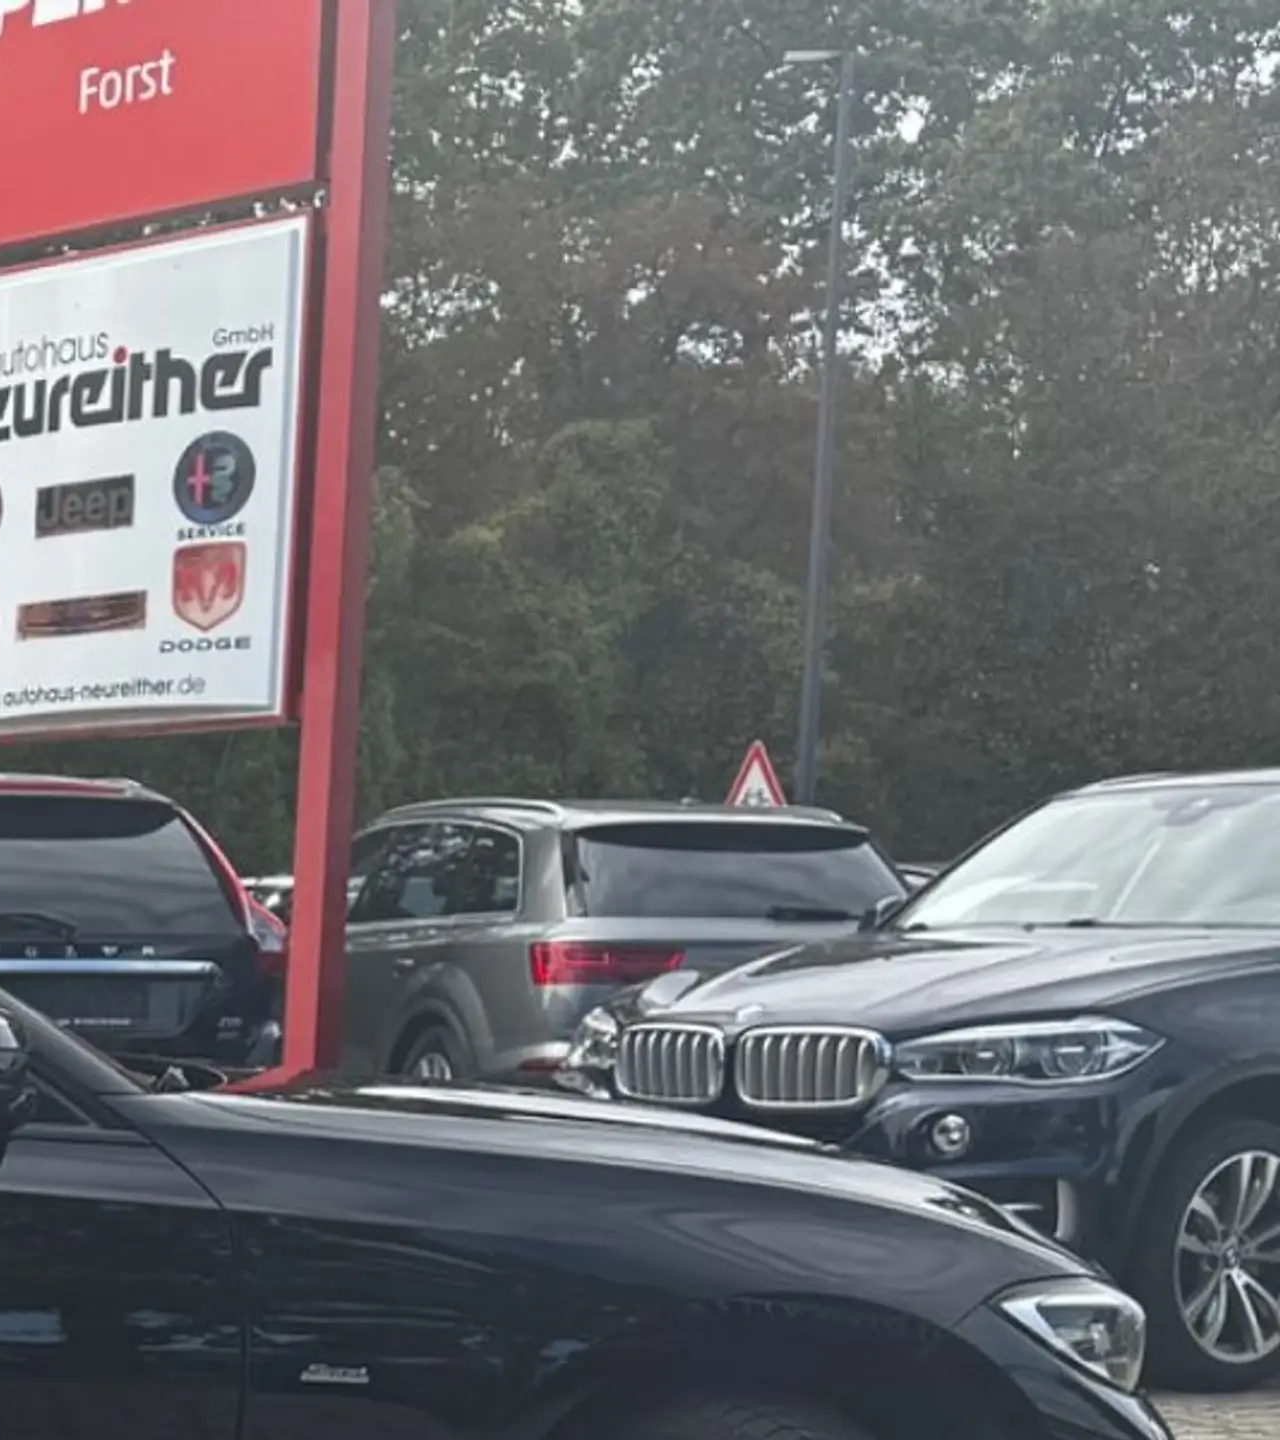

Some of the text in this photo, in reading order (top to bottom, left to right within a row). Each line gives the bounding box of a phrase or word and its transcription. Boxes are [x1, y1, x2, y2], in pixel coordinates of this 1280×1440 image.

[78, 48, 176, 114] Forst
[212, 323, 275, 347] GmbH
[40, 486, 134, 527] Jeep
[158, 636, 252, 653] DODGE
